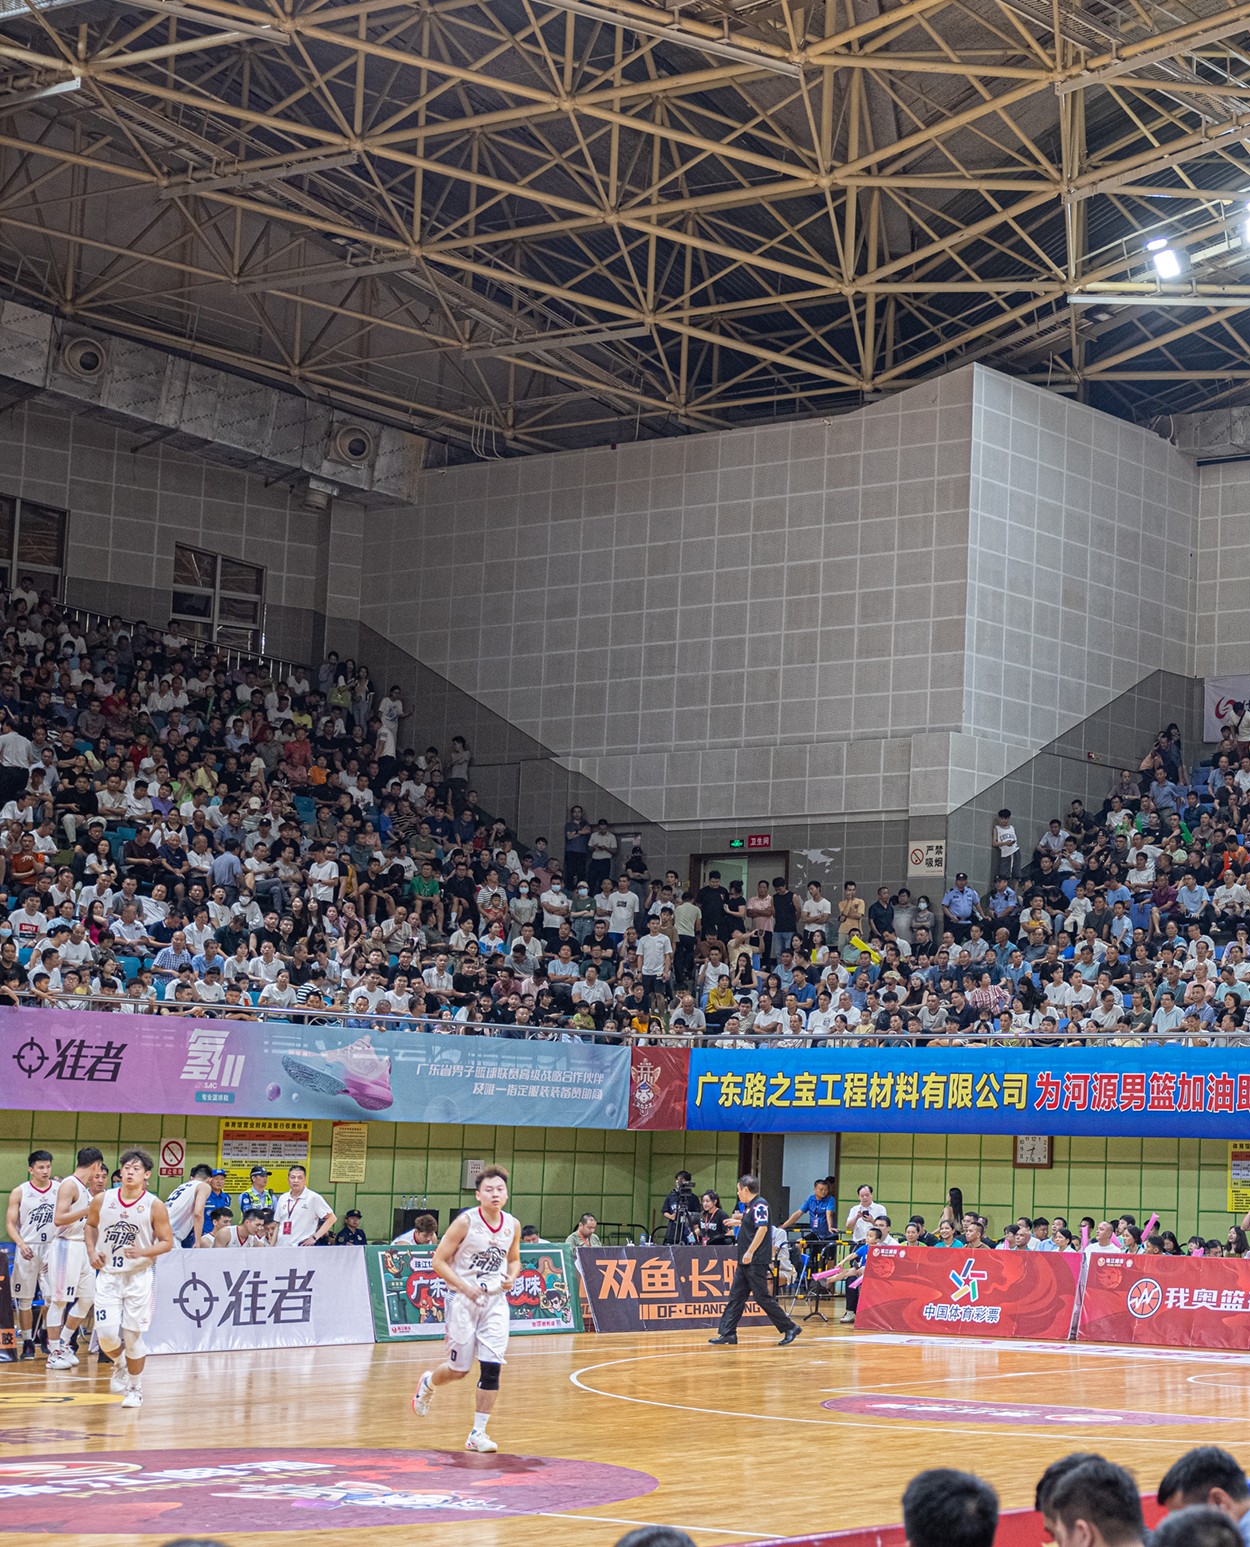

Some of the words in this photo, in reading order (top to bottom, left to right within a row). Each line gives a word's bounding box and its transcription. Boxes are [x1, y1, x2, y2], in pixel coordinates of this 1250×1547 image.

[750, 836, 769, 847] 卫生间
[926, 844, 944, 856] 严禁
[925, 857, 943, 868] 吸烟
[44, 1038, 128, 1082] 准者
[695, 1071, 1028, 1111] 广东路之宝工程材料有限公司
[112, 1256, 124, 1268] 13
[66, 1286, 75, 1296] 11
[217, 1268, 316, 1328] 准者
[96, 1309, 107, 1322] 13
[923, 1303, 1001, 1324] 中国体育彩票
